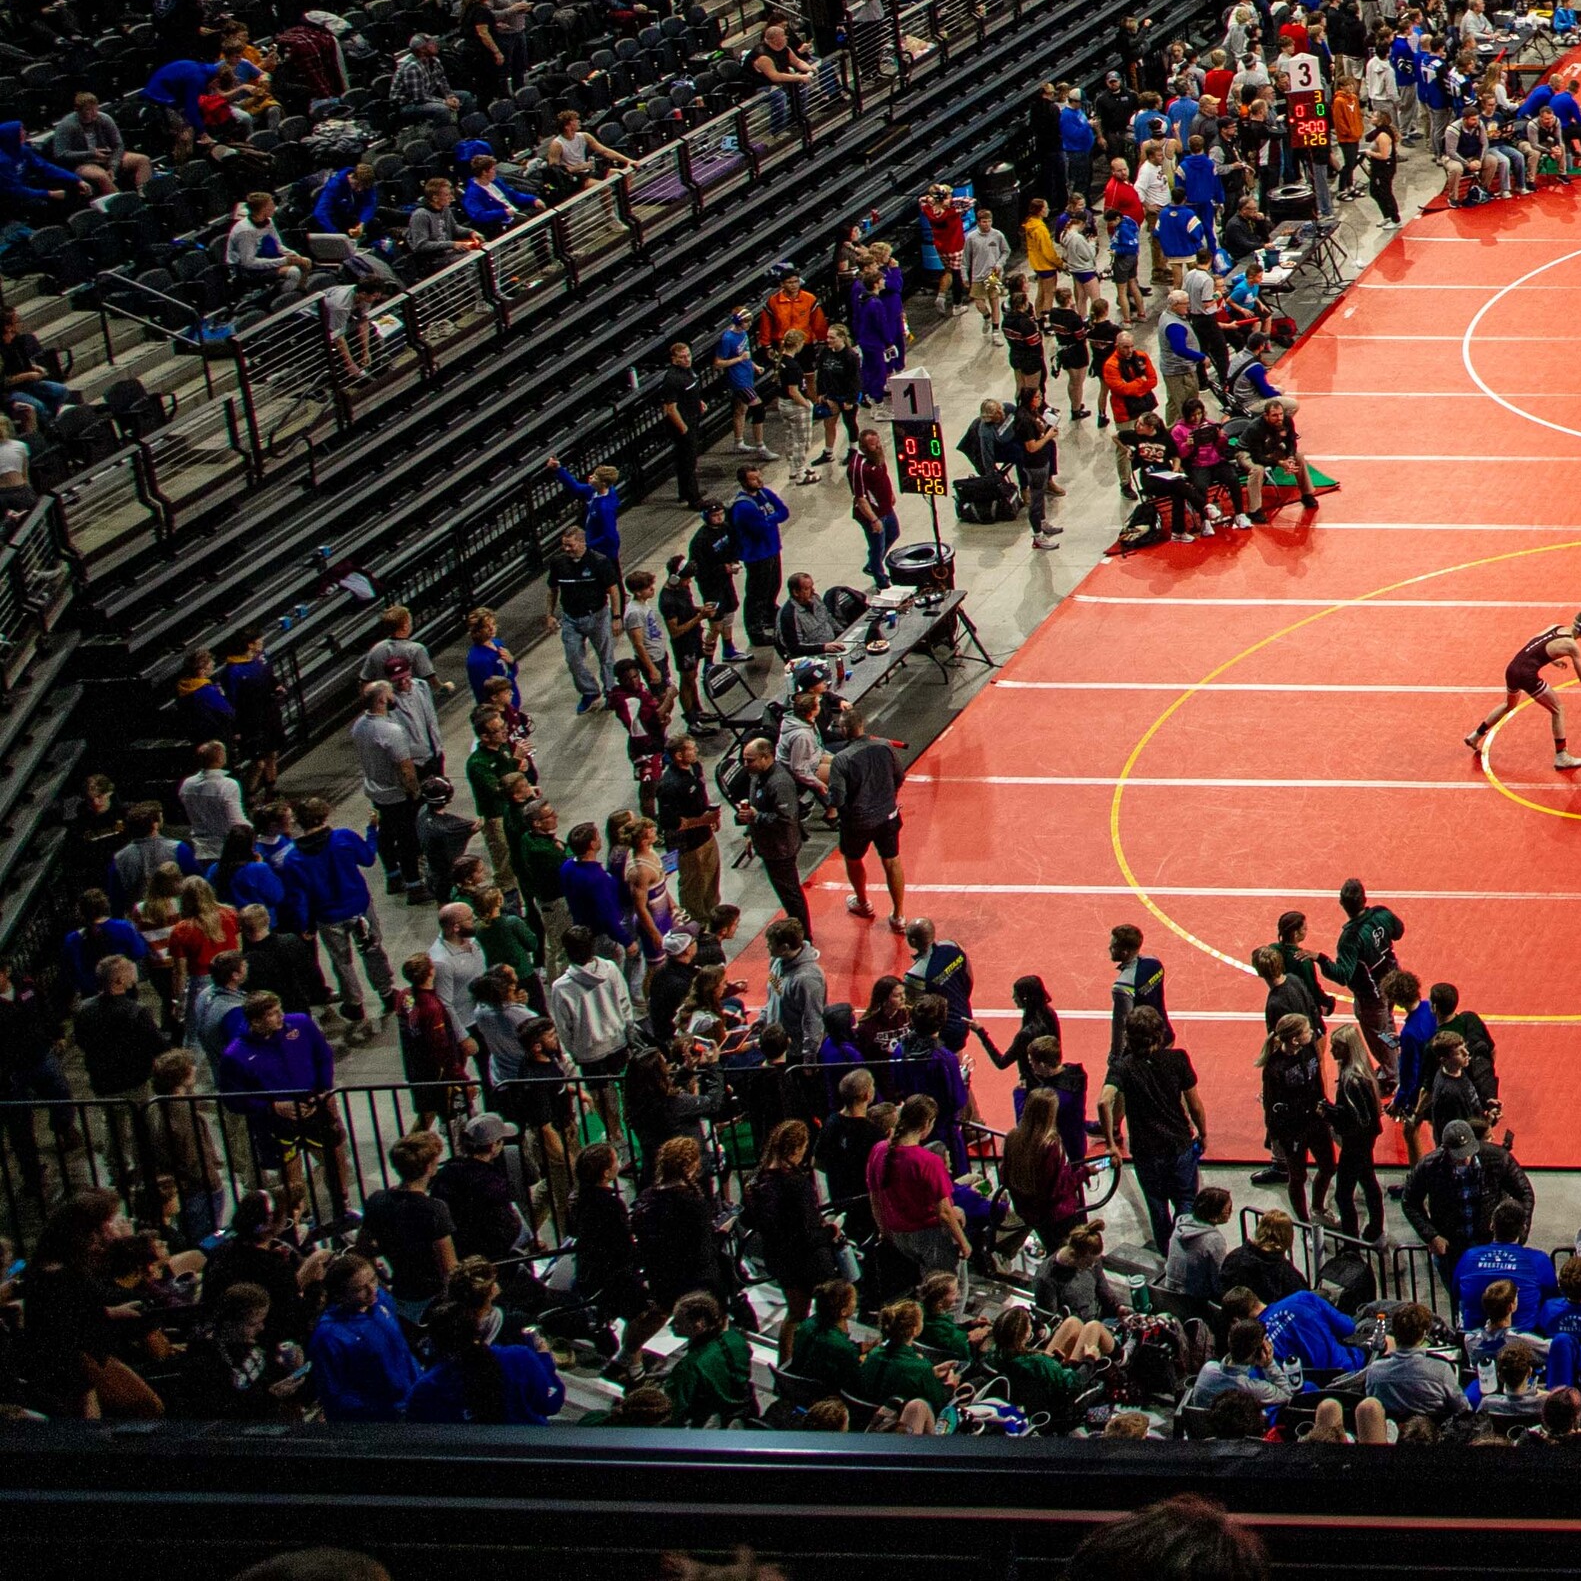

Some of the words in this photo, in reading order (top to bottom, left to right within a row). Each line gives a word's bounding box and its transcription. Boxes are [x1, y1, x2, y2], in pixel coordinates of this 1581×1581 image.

[1298, 63, 1311, 86] 3
[1298, 120, 1325, 134] 2:00
[1304, 133, 1327, 146] 126
[904, 383, 918, 414] 1
[908, 460, 942, 477] 2:00
[917, 478, 944, 495] 126
